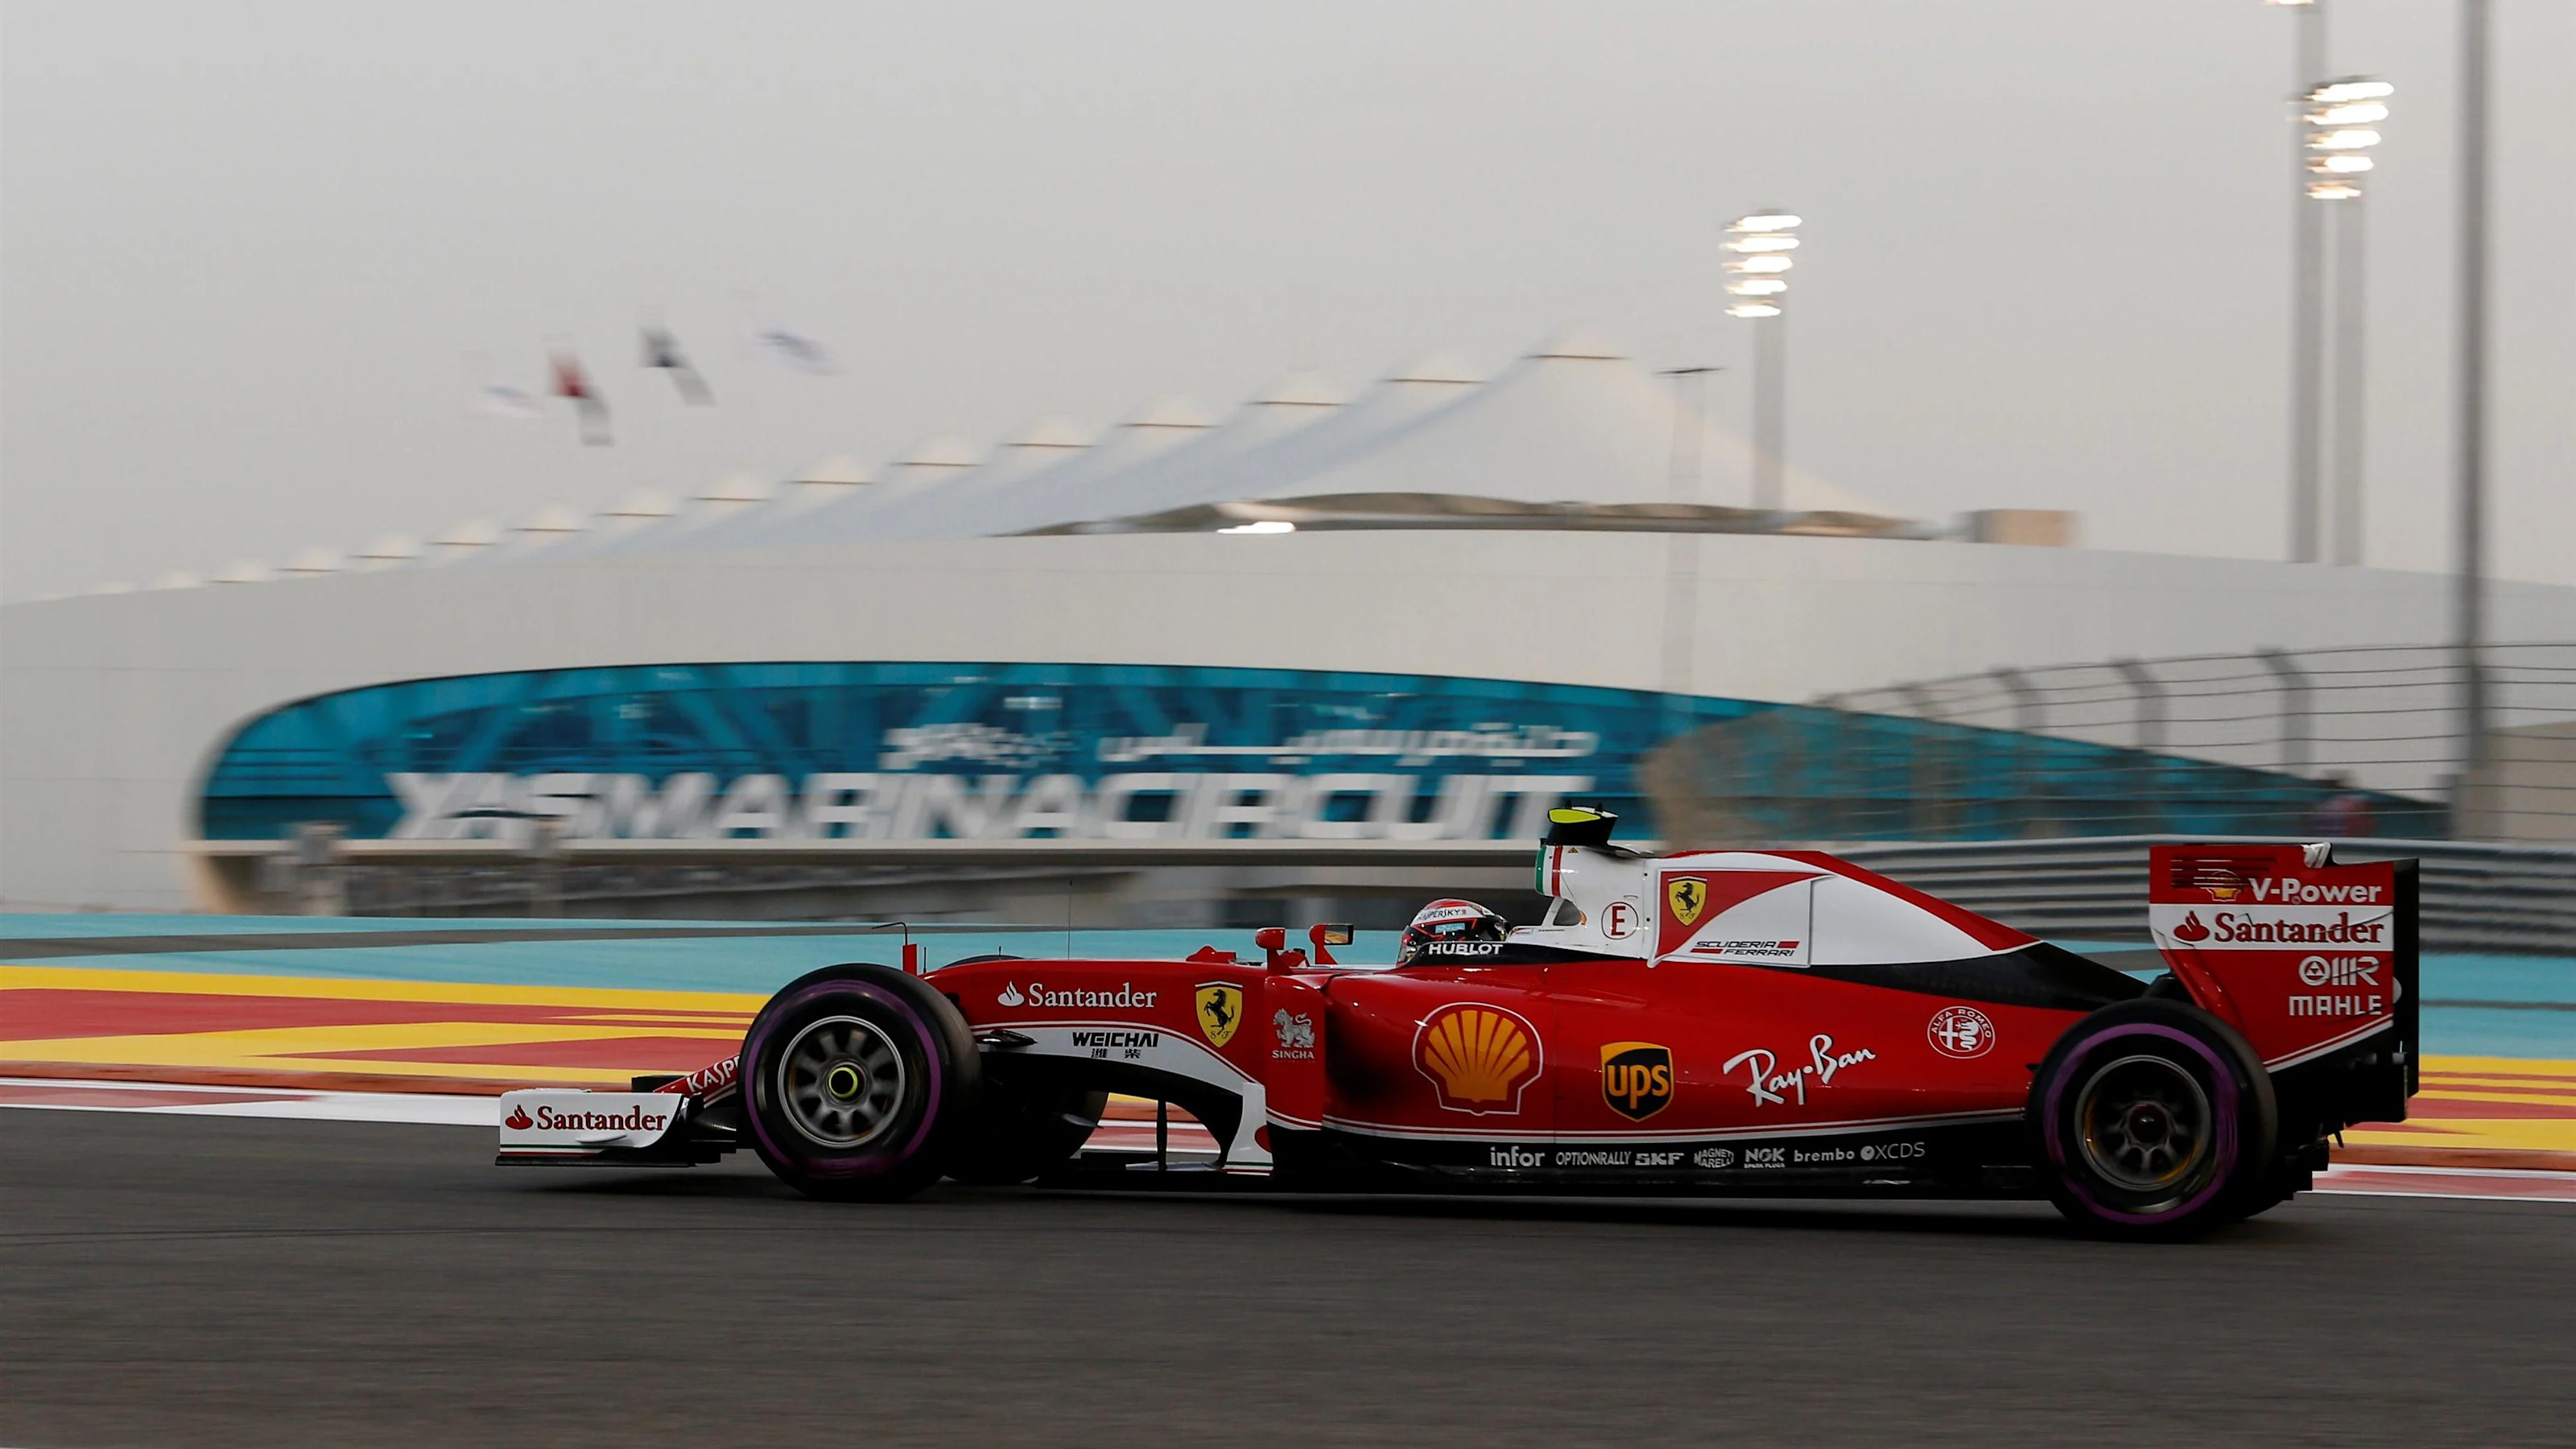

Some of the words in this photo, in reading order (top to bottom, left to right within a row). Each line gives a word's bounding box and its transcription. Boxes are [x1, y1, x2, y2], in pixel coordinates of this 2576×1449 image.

[2248, 877, 2382, 903] V-Power
[1611, 906, 1626, 936] E
[2215, 911, 2384, 943] Santander
[1428, 943, 1503, 956] HUBLOT
[1029, 981, 1157, 1008] Santander
[2289, 995, 2382, 1016] MAHLE
[1931, 1011, 1953, 1034] ALFA
[1958, 1009, 1992, 1038] ROMEO
[1072, 1032, 1159, 1047] WEICHAI
[1272, 1050, 1315, 1059] SINGHA
[1607, 1064, 1670, 1109] ups
[537, 1106, 667, 1131] Santander
[1490, 1146, 1546, 1166] infor
[1635, 1153, 1684, 1166] SKF
[1745, 1148, 1785, 1162] NGK
[1794, 1148, 1855, 1162] brembo
